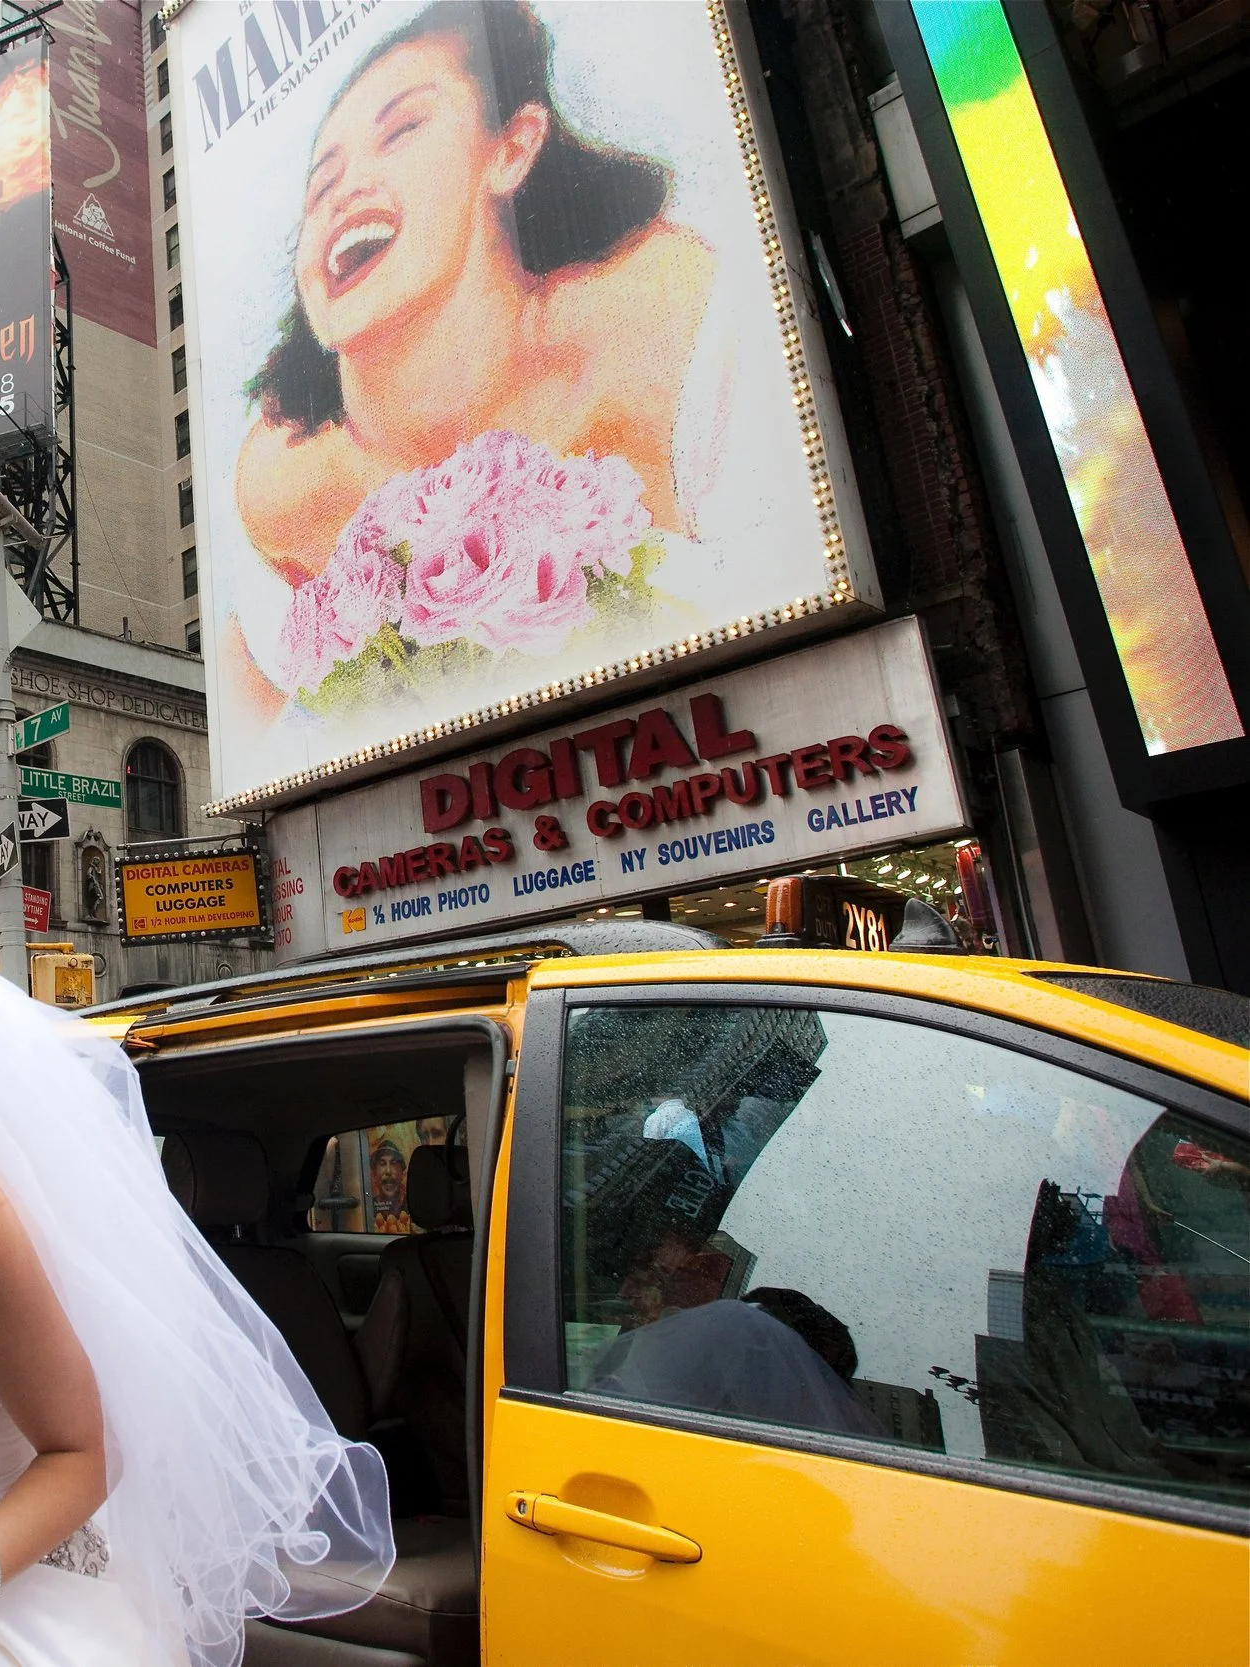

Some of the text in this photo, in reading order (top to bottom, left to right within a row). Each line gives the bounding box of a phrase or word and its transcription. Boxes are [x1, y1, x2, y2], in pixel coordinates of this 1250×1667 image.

[250, 92, 278, 127] THE
[280, 41, 330, 101] SMASH
[332, 12, 358, 47] HIT
[88, 236, 115, 255] Coffee
[115, 248, 136, 264] Fund
[10, 666, 61, 696] SHOE
[67, 681, 120, 708] SHOP
[30, 708, 63, 742] 7 AV
[419, 691, 756, 835] DIGITAL
[21, 769, 120, 798] LITTLE BRAZIL
[58, 790, 86, 802] STREET
[332, 724, 911, 898] CAMERAS & COMPUTERS
[391, 896, 432, 923] HOUR
[438, 883, 491, 913] PHOTO
[513, 859, 597, 897] LUGGAGE
[620, 847, 648, 874] NY
[657, 820, 776, 866] SOUVENIRS
[807, 785, 918, 833] GALLERY
[126, 859, 250, 881] DIGITAL CAMERAS
[25, 892, 48, 907] STANDING
[145, 878, 234, 897] COMPUTERS
[156, 895, 226, 913] LUGGAGE
[150, 917, 162, 928] 1/2
[164, 915, 187, 927] HOUR
[188, 914, 206, 924] FILM
[207, 910, 255, 924] DEVELOPING
[842, 901, 888, 952] 2Y81
